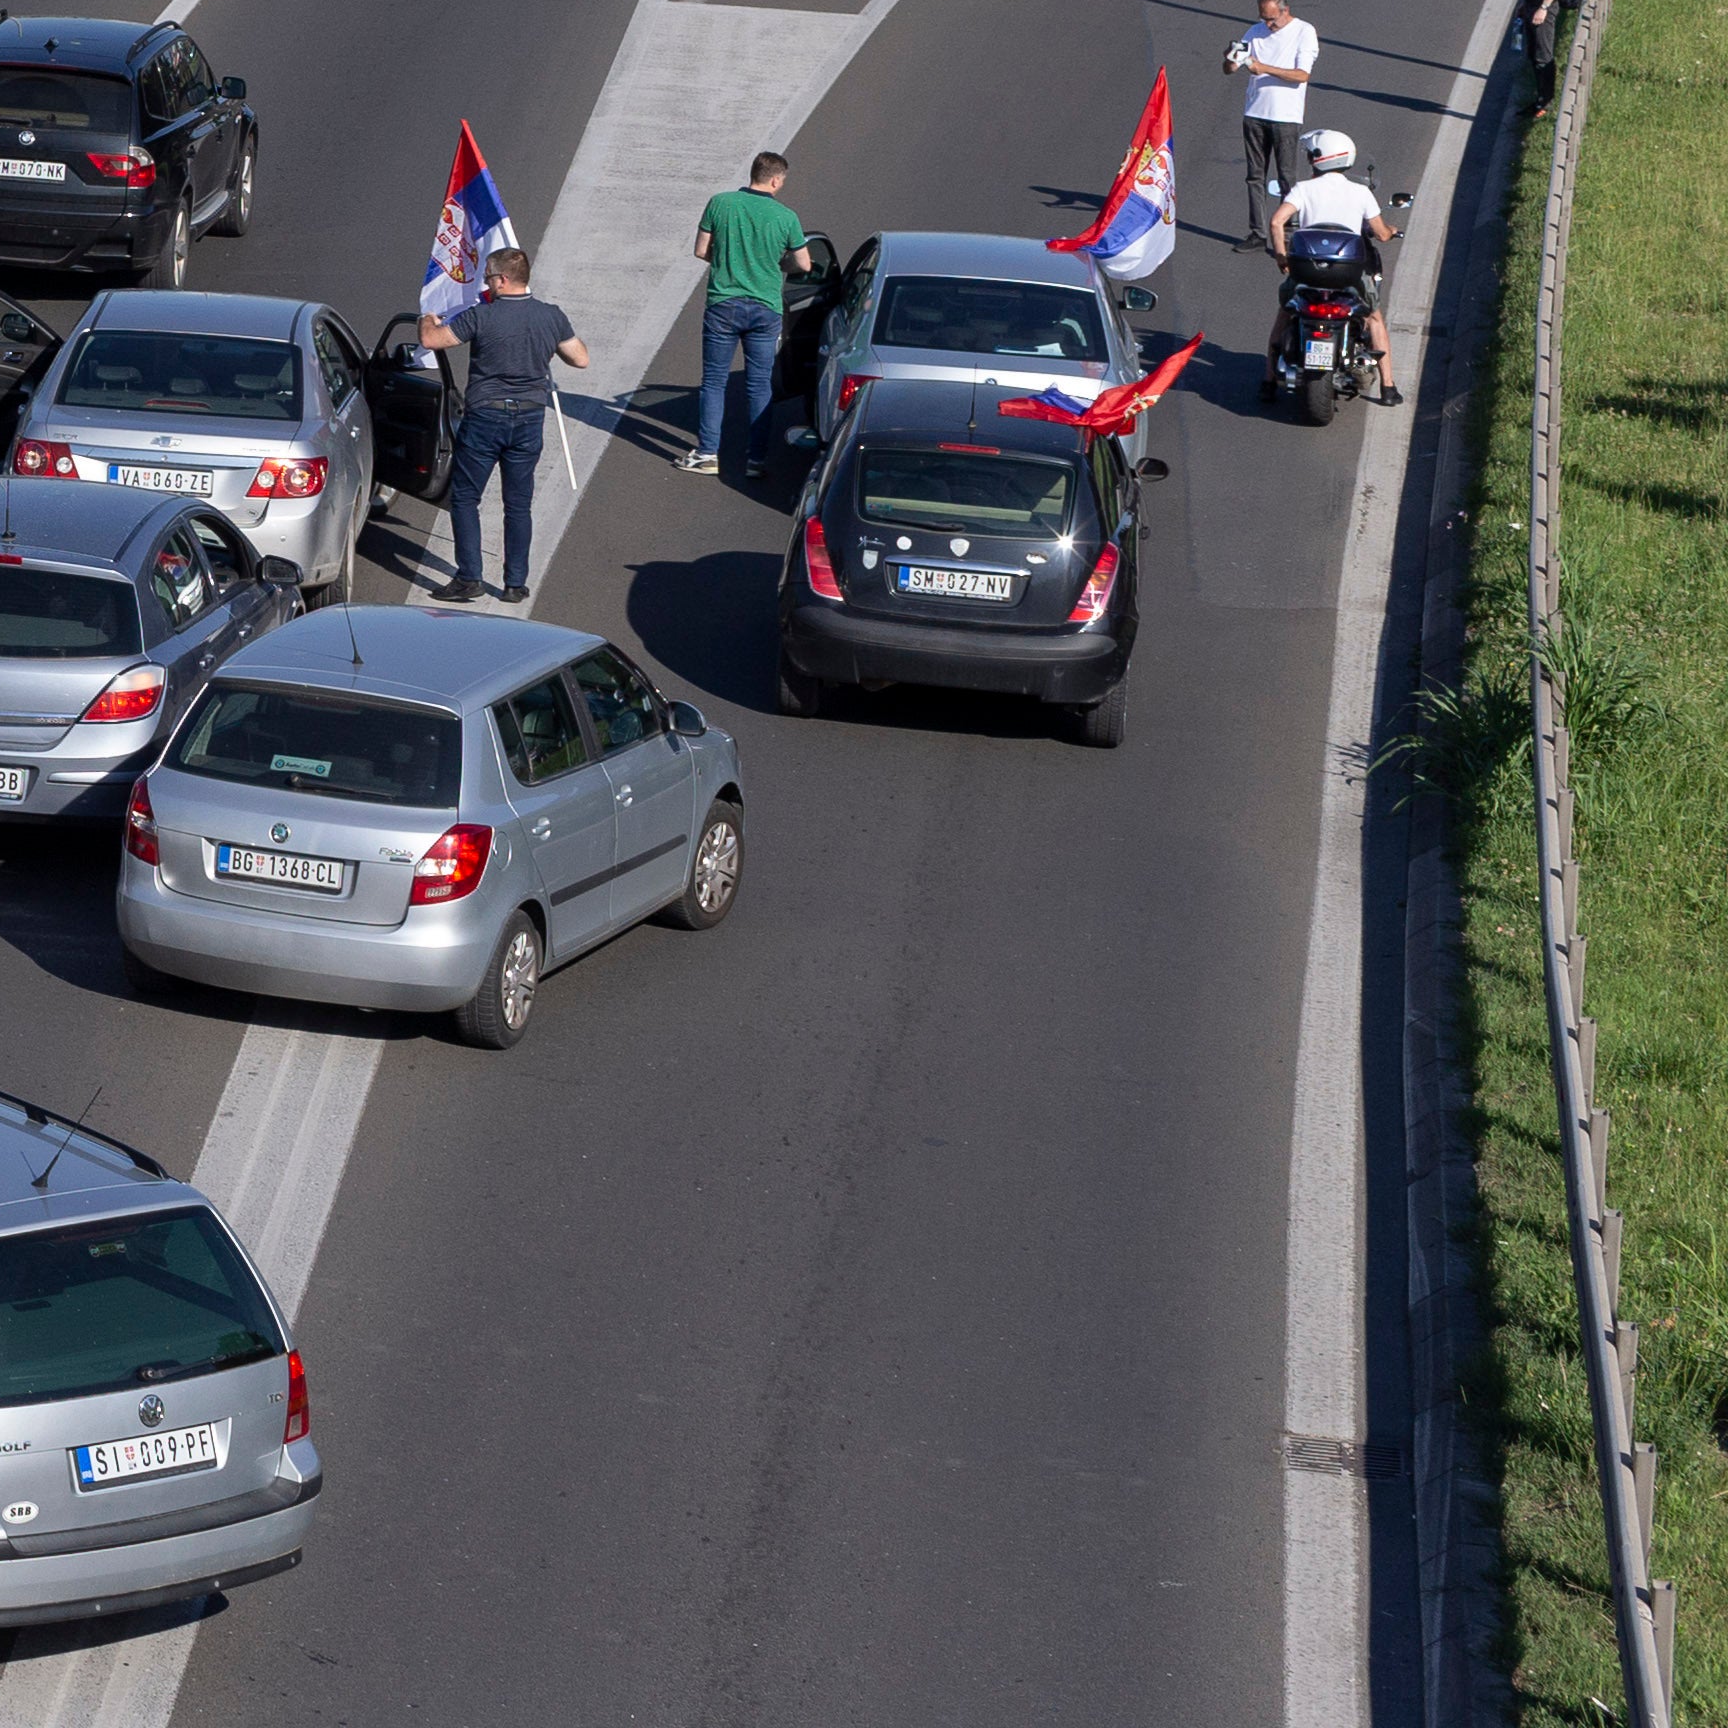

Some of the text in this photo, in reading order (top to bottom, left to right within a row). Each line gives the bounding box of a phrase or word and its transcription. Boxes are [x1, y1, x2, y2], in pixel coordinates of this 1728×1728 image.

[121, 469, 140, 486] VA
[913, 570, 934, 587] SM
[232, 850, 253, 872] BG
[96, 1446, 120, 1475] ŠI
[9, 1506, 31, 1517] SRB
